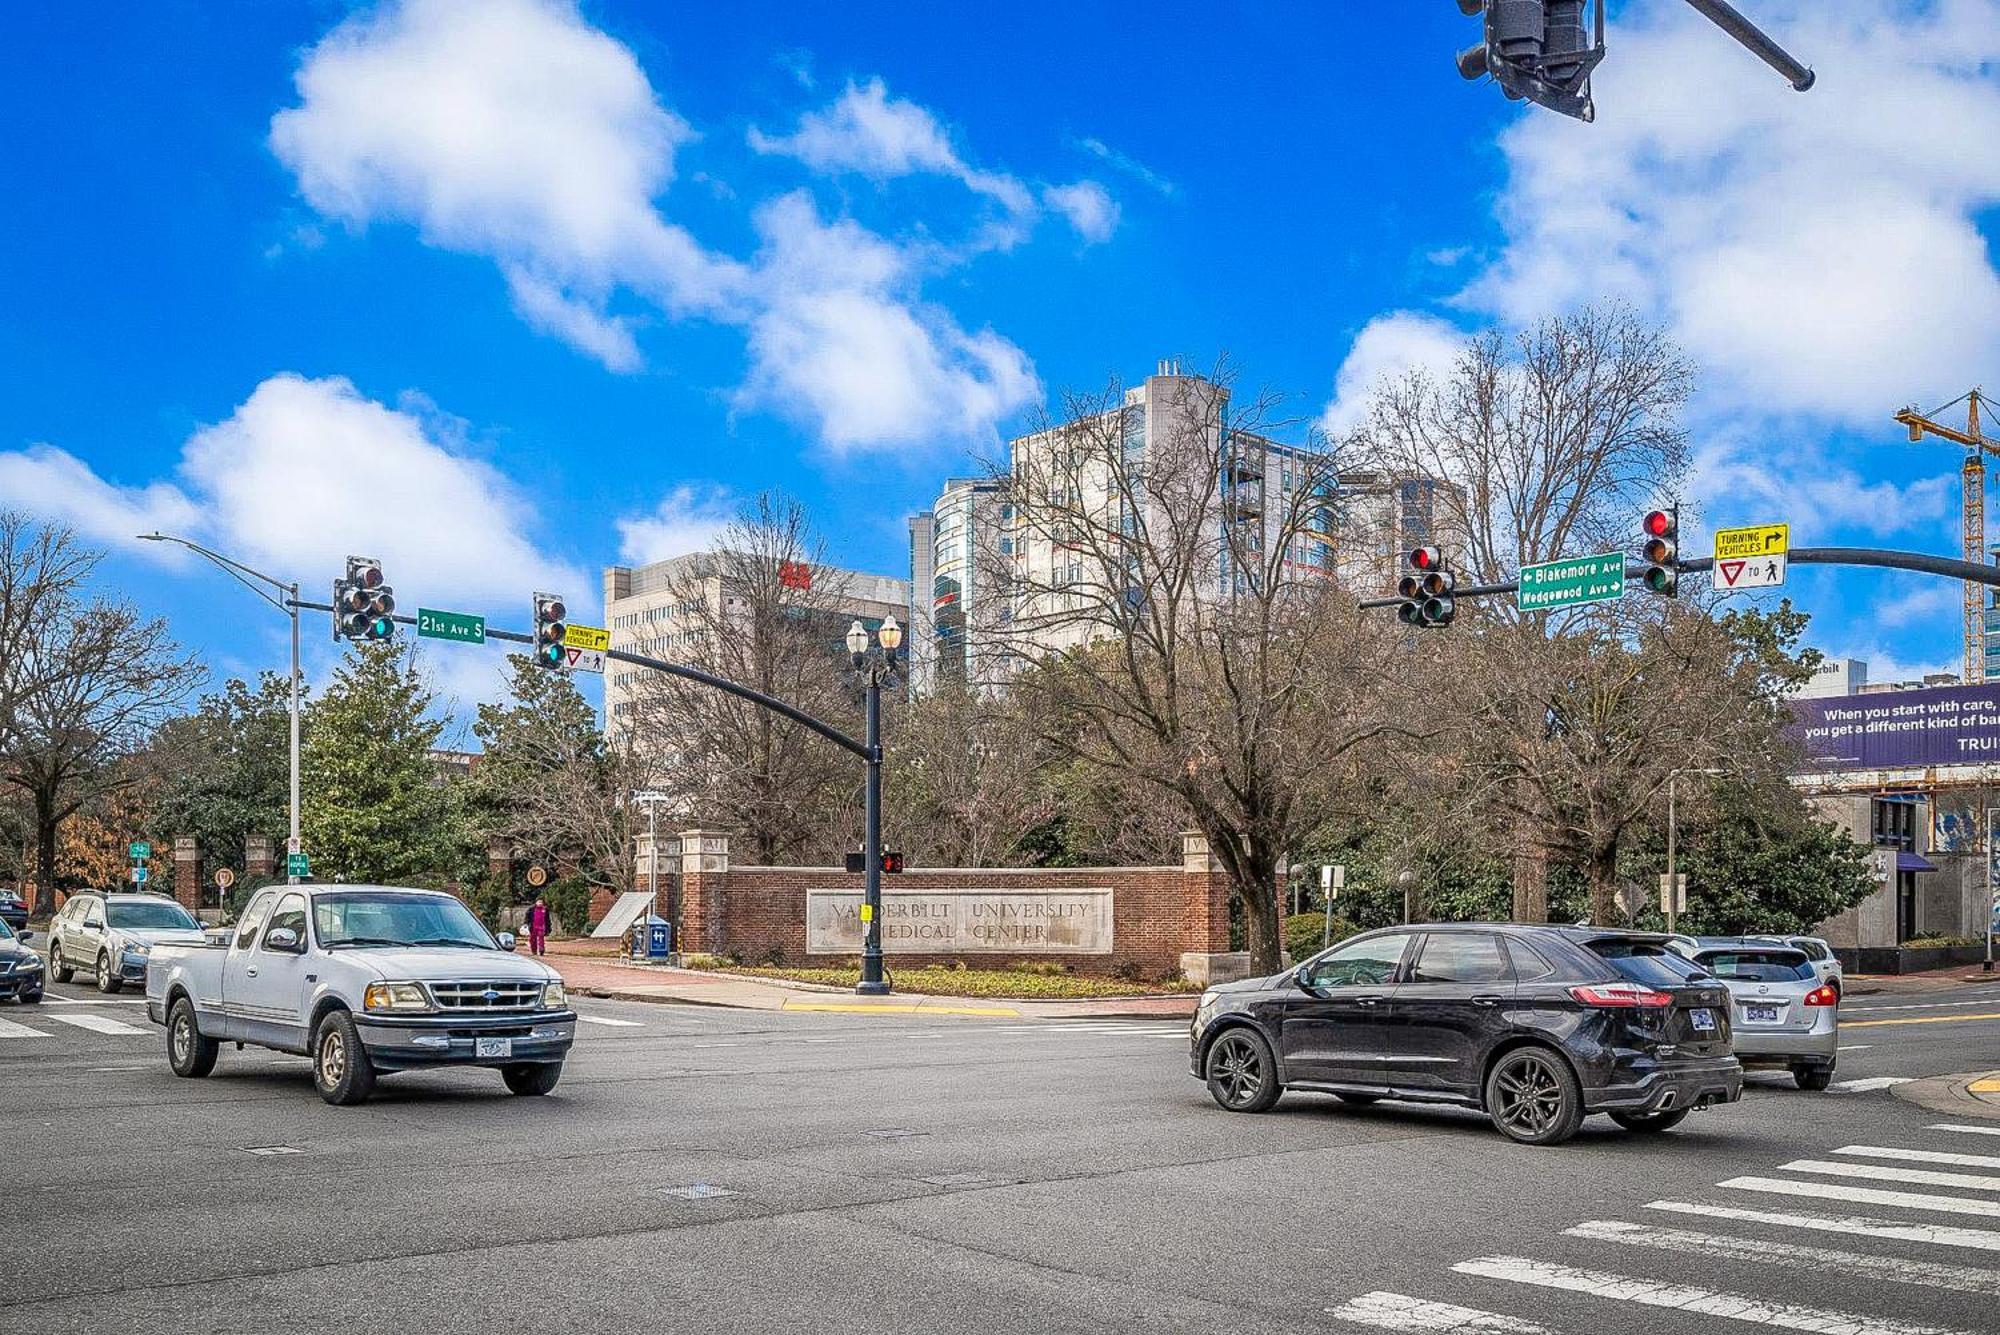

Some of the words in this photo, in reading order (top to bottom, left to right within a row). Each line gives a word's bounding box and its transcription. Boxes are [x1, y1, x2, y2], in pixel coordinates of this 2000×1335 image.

[1721, 532, 1760, 545] TURNING
[1719, 542, 1761, 555] VEHICLES
[1535, 563, 1597, 584] Blakemore
[1602, 562, 1621, 574] Ave
[1748, 566, 1760, 577] TO
[1522, 585, 1582, 604] Wedgewood
[1589, 584, 1608, 595] Ave
[420, 615, 445, 633] 21st
[450, 623, 469, 636] Ave
[474, 622, 482, 638] S
[1814, 662, 1840, 674] rbilt
[1823, 709, 1862, 721] When
[1864, 707, 1889, 720] you
[1891, 703, 1925, 716] start
[1927, 700, 1960, 714] with
[1962, 699, 1997, 712] care,
[1804, 727, 1829, 740] you
[1831, 724, 1853, 738] get
[1855, 724, 1863, 734] a
[1865, 718, 1925, 733] different
[1927, 715, 1958, 729] kind
[1961, 714, 1977, 727] of
[1957, 737, 2000, 751] TRUI
[832, 903, 951, 918] VAERBILT
[972, 903, 1090, 918] UNIVERSITY
[880, 924, 957, 939] EDICAL
[972, 924, 1047, 940] CENTER
